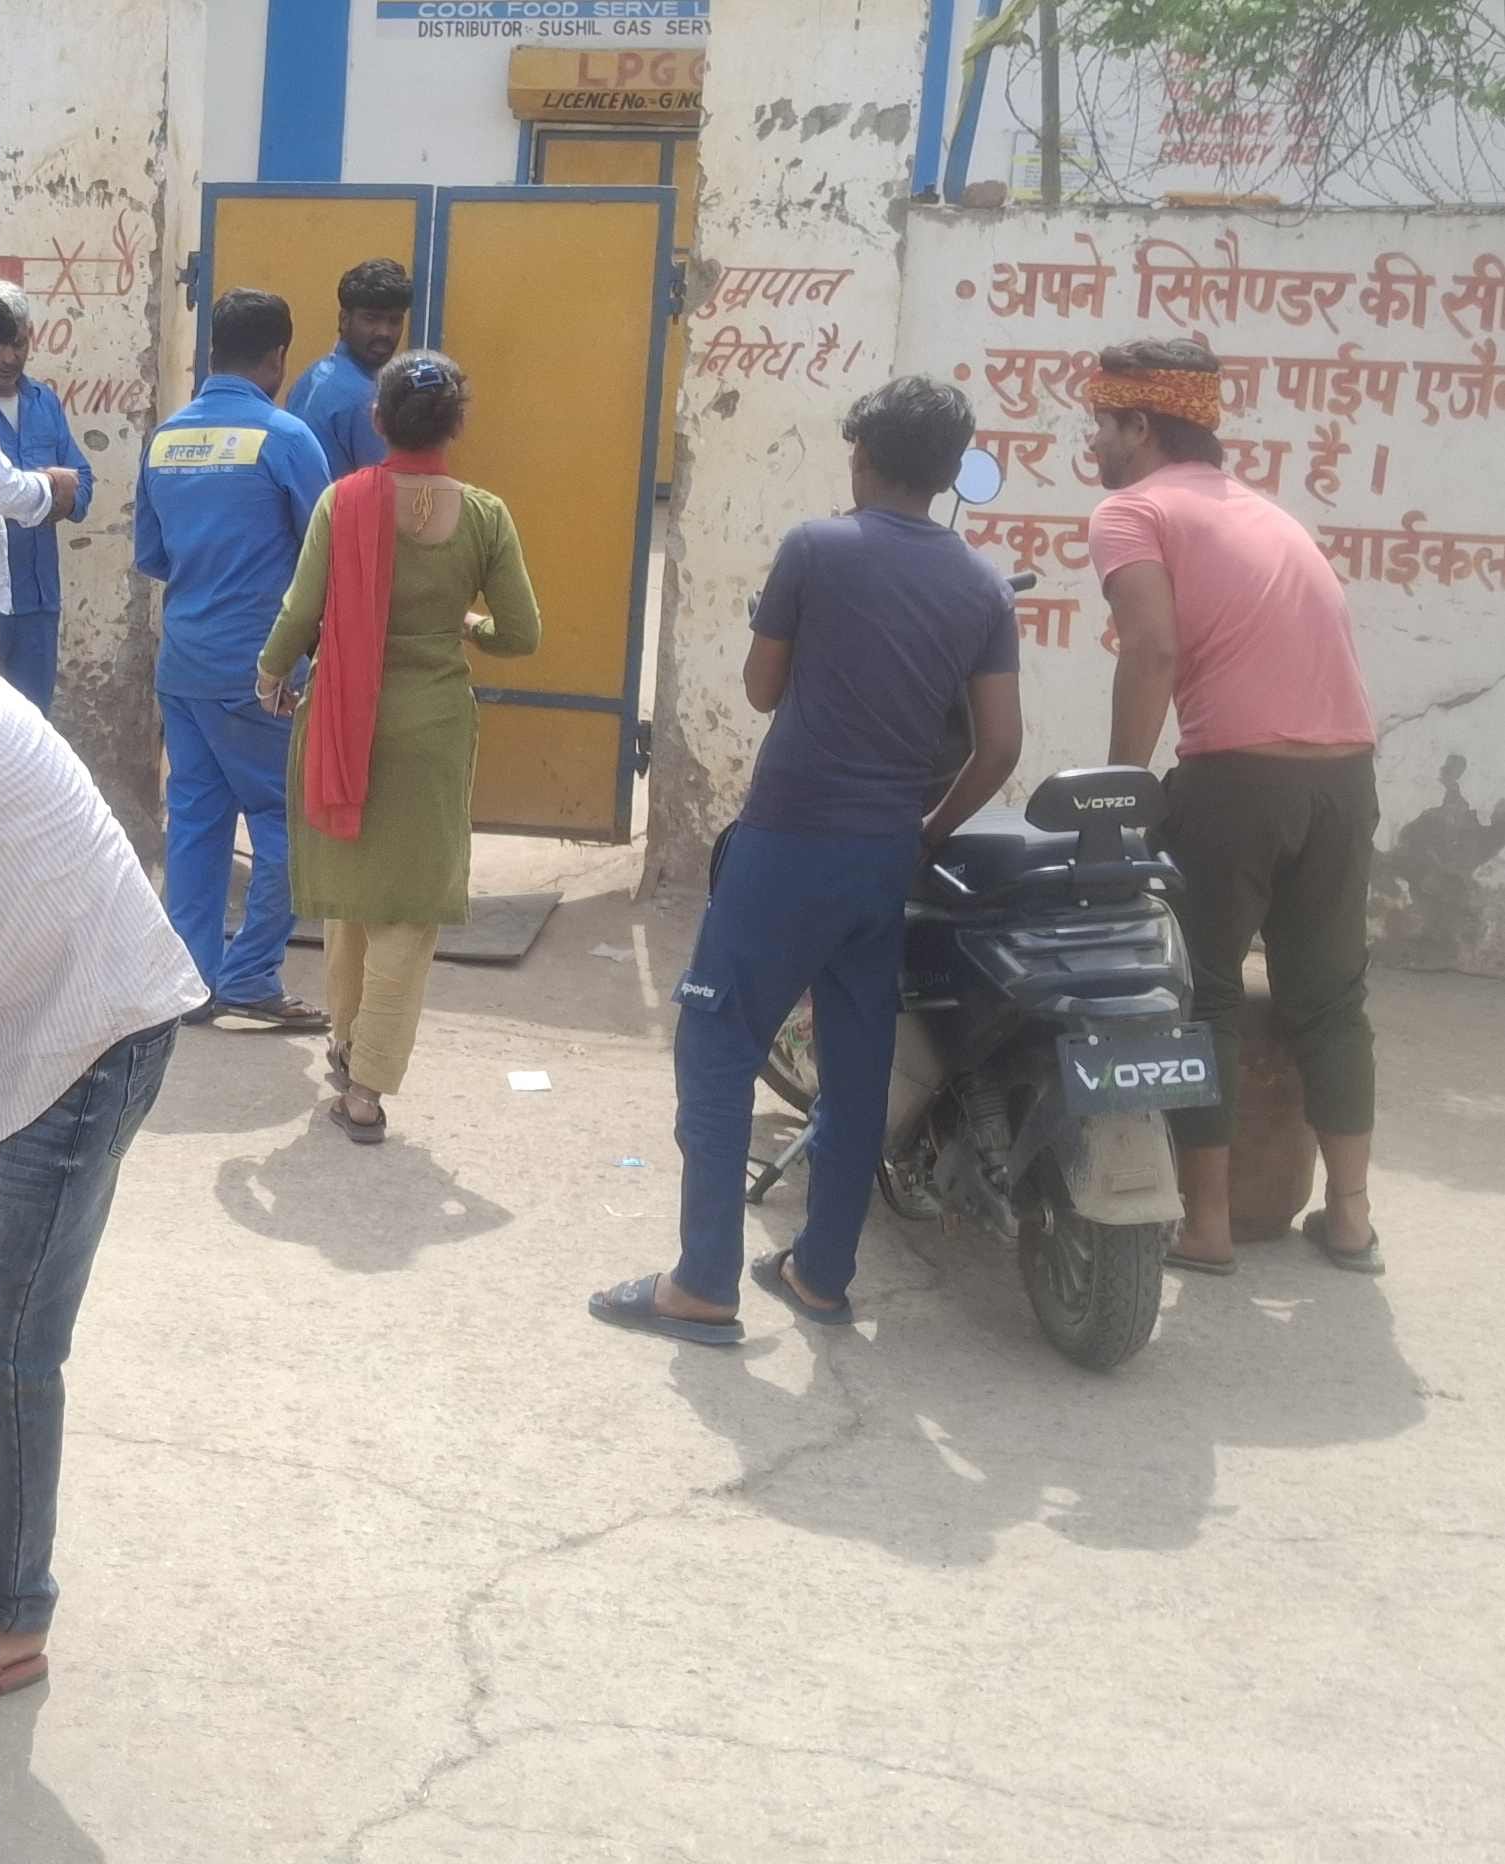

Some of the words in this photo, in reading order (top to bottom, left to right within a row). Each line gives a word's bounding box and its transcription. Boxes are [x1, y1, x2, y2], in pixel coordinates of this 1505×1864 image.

[417, 1, 494, 17] COOK
[507, 1, 579, 17] FOOD
[595, 1, 680, 17] SERVE
[537, 20, 602, 37] SUSHIL
[612, 20, 652, 36] GAS
[576, 52, 677, 89] LPG
[986, 231, 1117, 319] अपने
[1359, 250, 1438, 330] की
[1272, 341, 1409, 425] पाईप
